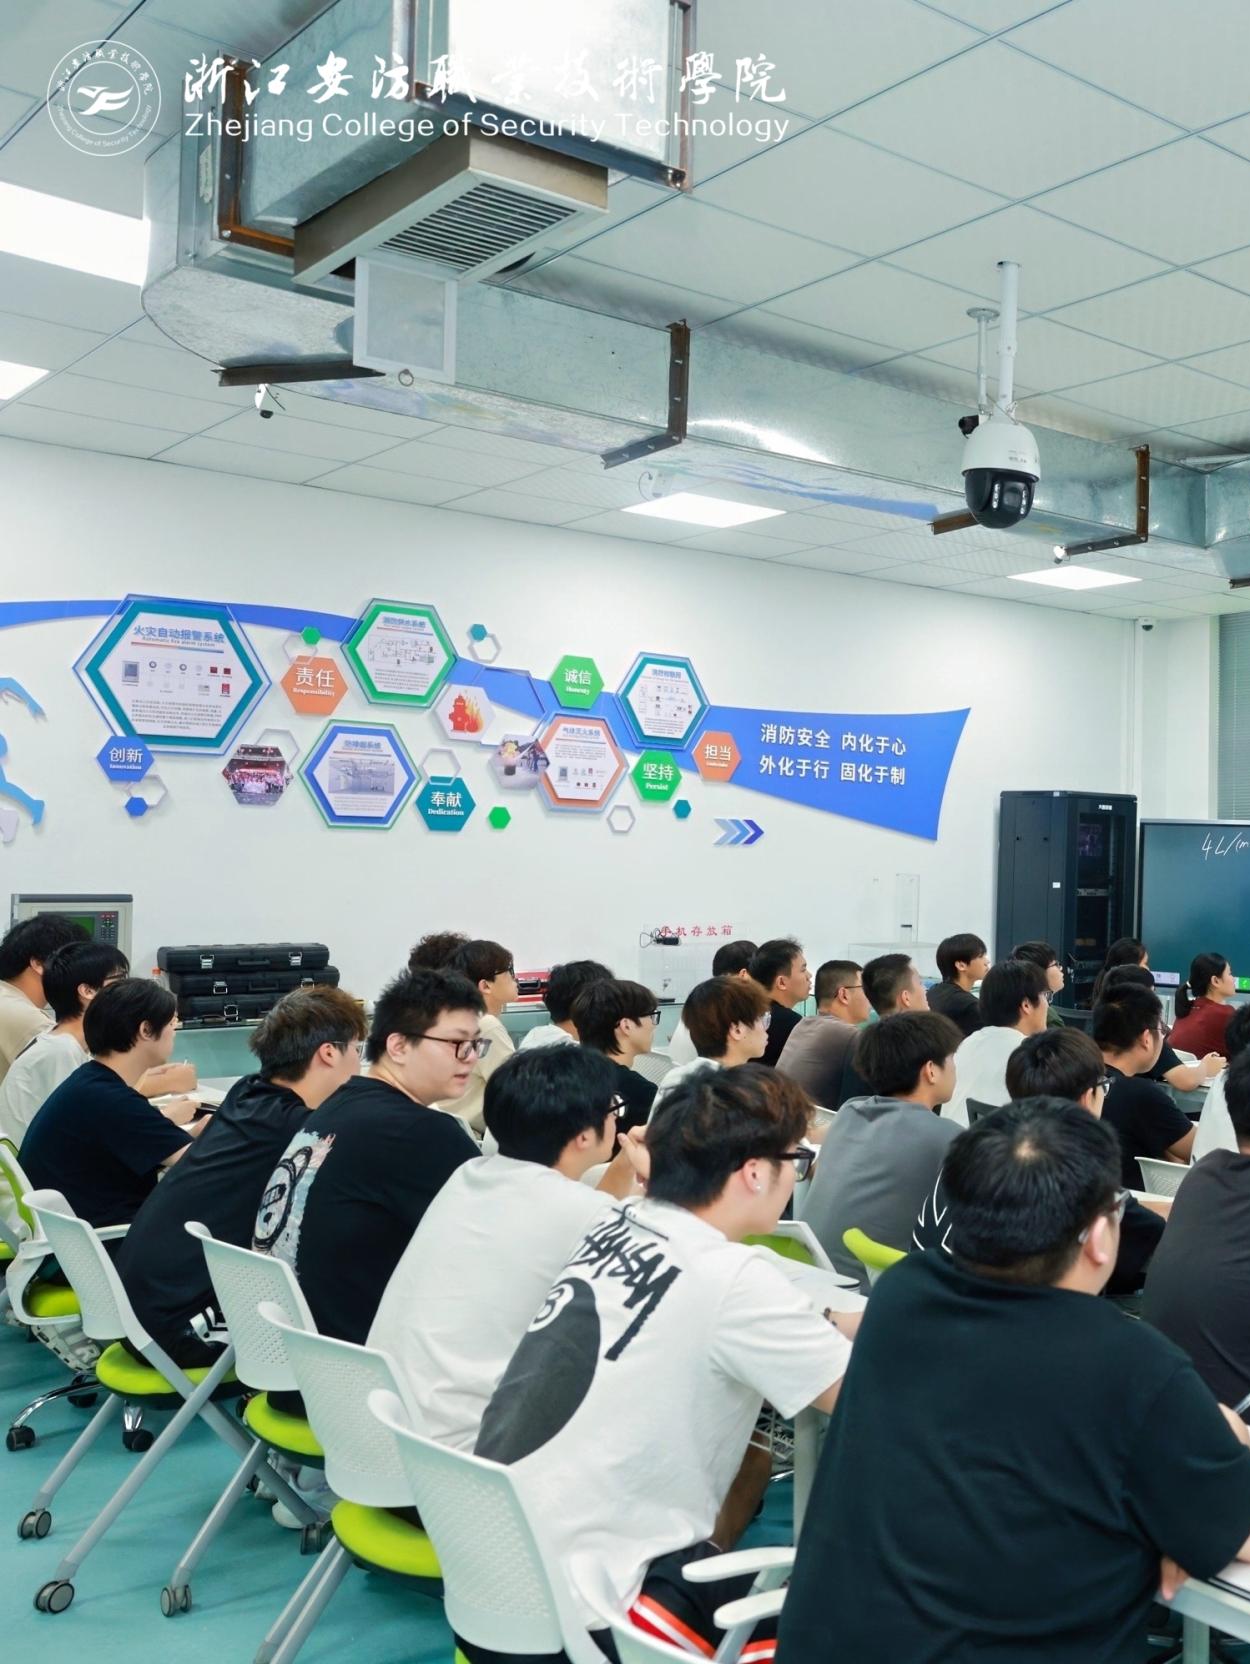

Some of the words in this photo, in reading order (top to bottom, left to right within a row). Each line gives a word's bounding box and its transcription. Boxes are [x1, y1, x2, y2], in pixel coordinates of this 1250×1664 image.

[295, 667, 336, 688] 责任
[563, 668, 592, 685] 诚信
[760, 723, 831, 749] 消防安全
[841, 732, 907, 756] 内化于心
[108, 747, 144, 763] 创新
[704, 743, 732, 761] 担当
[642, 763, 674, 781] 坚持
[759, 755, 831, 779] 外化于行
[840, 762, 906, 786] 固化于制
[430, 791, 463, 808] 奉献
